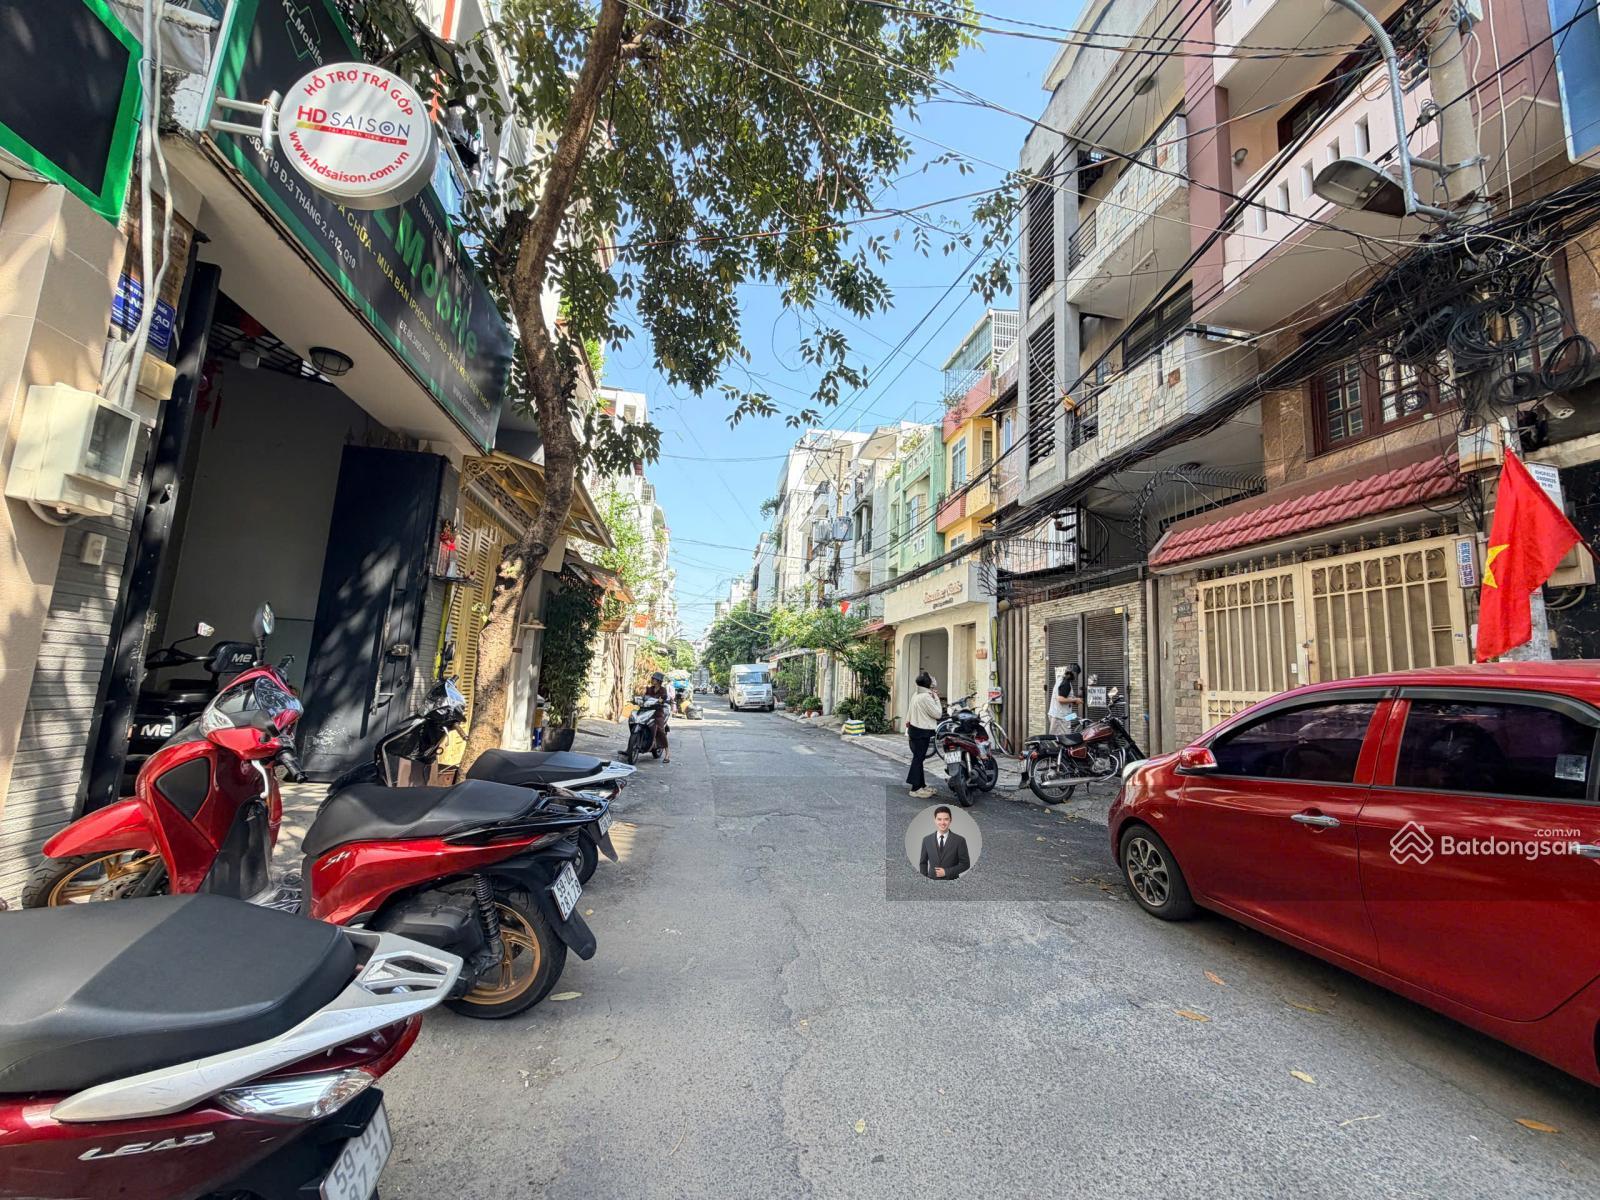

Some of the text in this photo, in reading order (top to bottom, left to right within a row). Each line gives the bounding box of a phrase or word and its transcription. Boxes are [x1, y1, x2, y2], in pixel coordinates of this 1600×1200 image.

[326, 69, 358, 84] TRỢ
[362, 71, 391, 92] TRẢ
[296, 105, 411, 138] HD SAISON
[289, 131, 410, 183] www.hdsaison.com.vn
[295, 186, 321, 226] THÁNG
[376, 252, 395, 283] MUA
[394, 277, 410, 303] BÁN
[77, 1130, 216, 1161] LEAD
